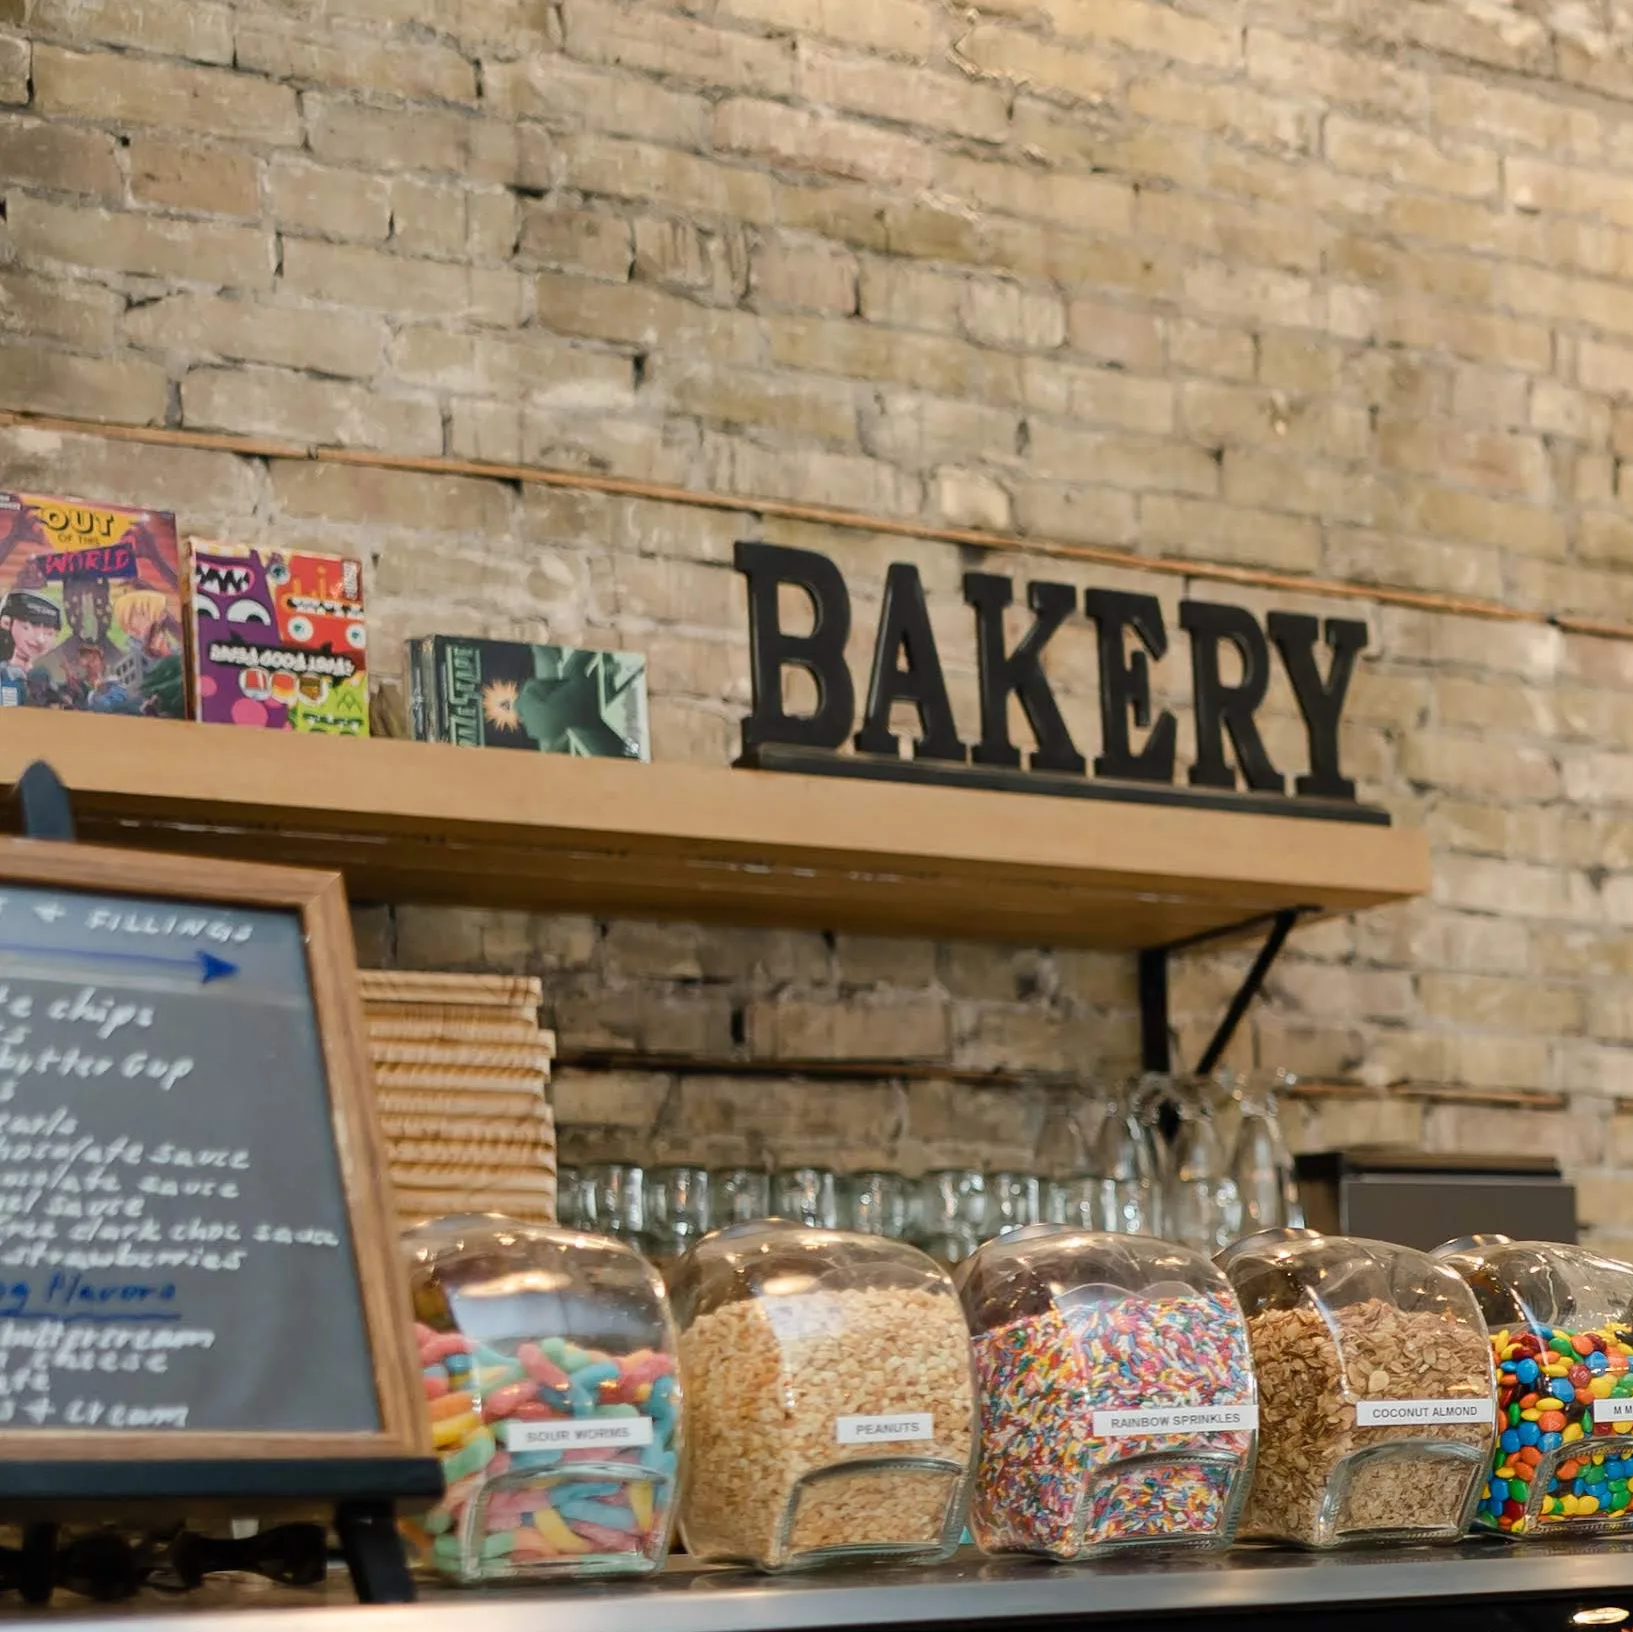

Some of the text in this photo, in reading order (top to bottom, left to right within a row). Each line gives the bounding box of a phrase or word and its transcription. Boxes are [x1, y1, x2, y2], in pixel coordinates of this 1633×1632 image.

[44, 505, 114, 537] OUT
[734, 540, 1369, 800] BAKERY
[85, 905, 254, 943] FILLINGS
[48, 986, 155, 1040] chips
[148, 1143, 250, 1169] sauce
[137, 1175, 240, 1199] sauce
[68, 1216, 162, 1243] dark
[63, 1399, 190, 1428] cream
[1110, 1411, 1241, 1430] RAINBOW SPRINKLES
[1371, 1405, 1478, 1419] COCONUT ALMOND
[526, 1427, 631, 1443] SOUR WORMS
[855, 1422, 920, 1436] PEANUTS
